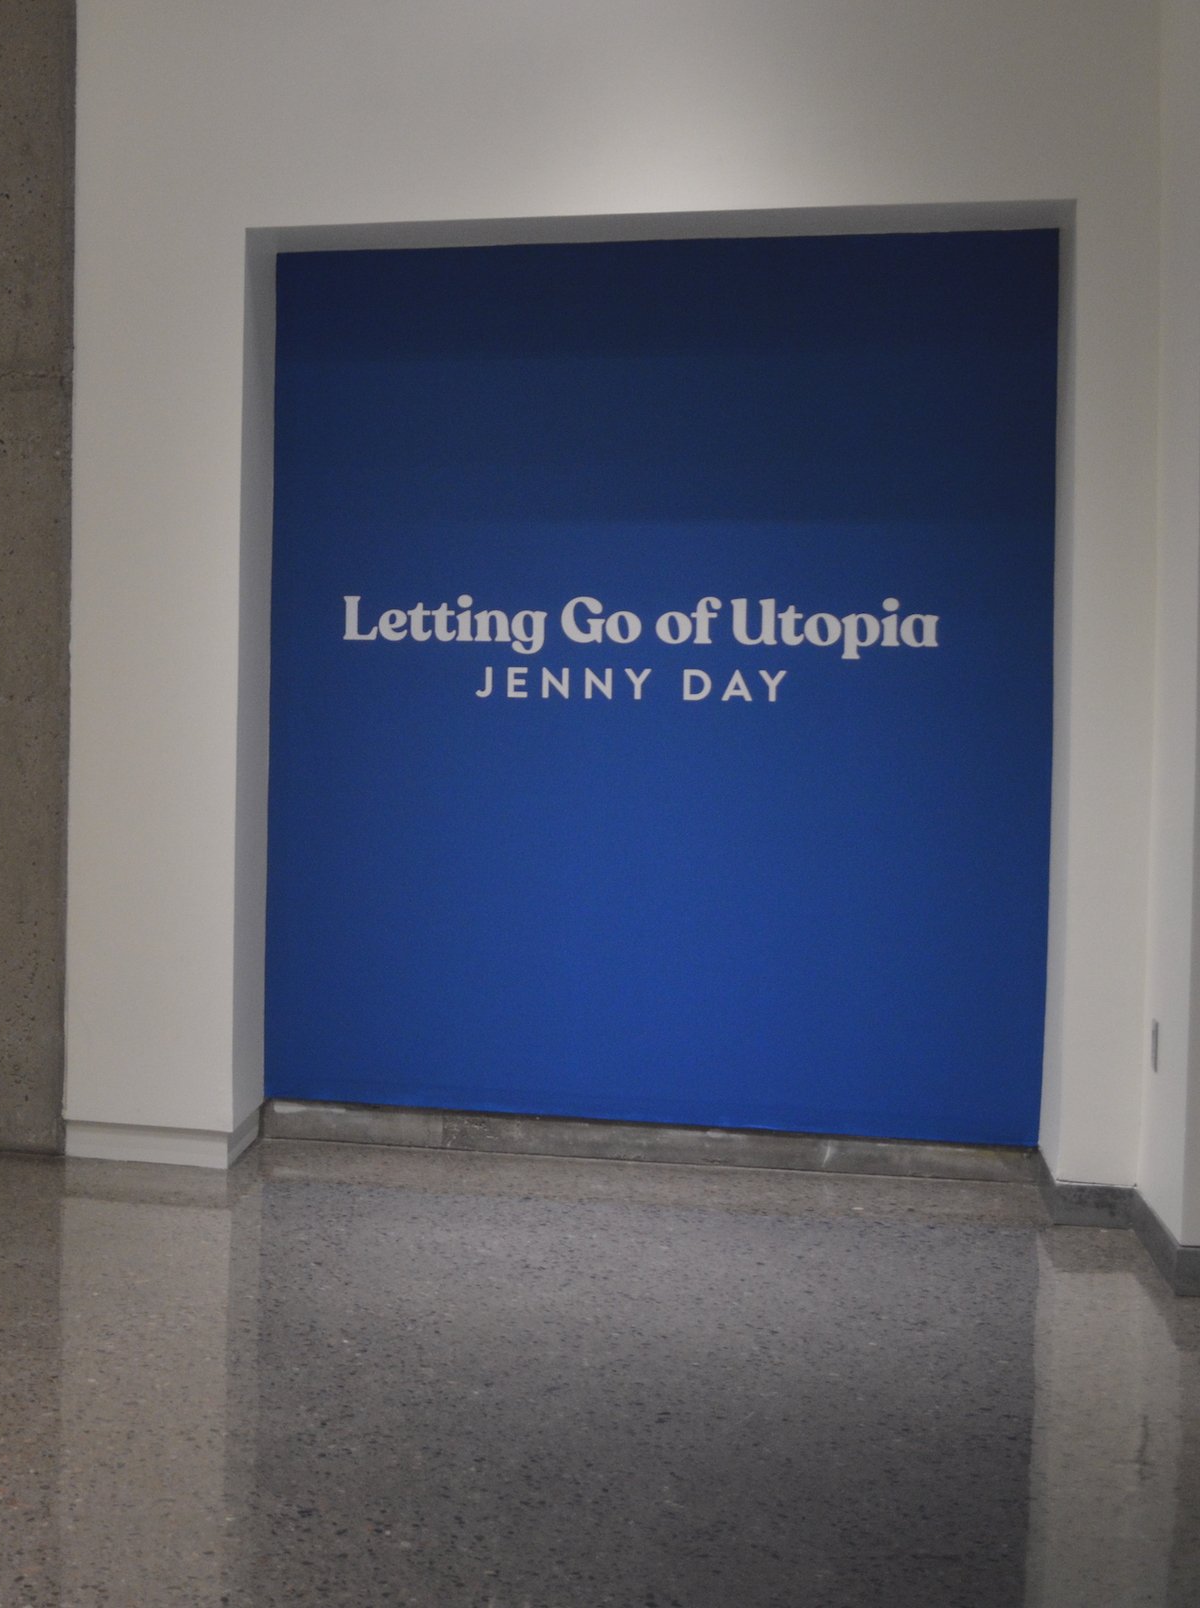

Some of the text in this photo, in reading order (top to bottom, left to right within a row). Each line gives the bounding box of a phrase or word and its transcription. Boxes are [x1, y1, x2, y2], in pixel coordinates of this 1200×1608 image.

[343, 594, 939, 660] Letting Go of Utopia
[475, 666, 787, 702] JENNY DAY
